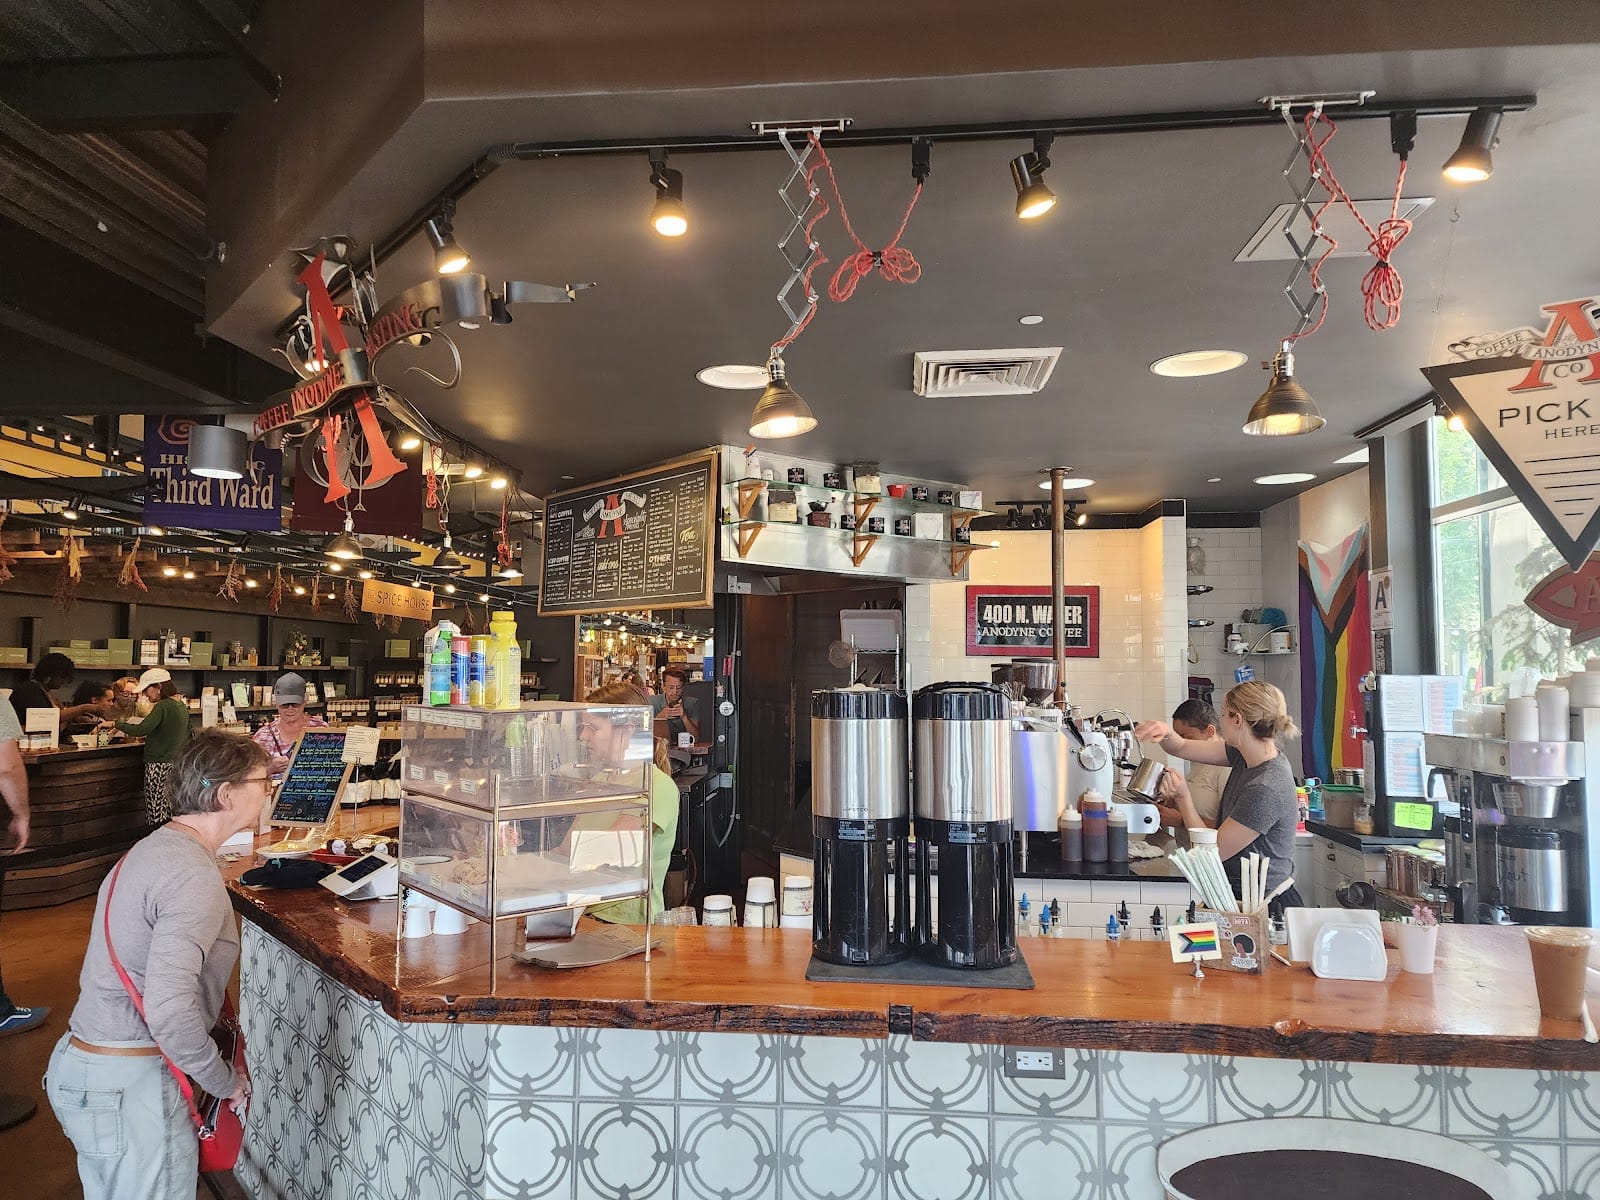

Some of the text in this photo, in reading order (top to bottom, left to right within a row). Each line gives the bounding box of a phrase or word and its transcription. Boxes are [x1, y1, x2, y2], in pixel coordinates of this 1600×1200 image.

[1475, 332, 1600, 358] COFFEE ANODYN
[1553, 362, 1584, 378] CO
[1499, 398, 1592, 428] PICK
[1545, 424, 1600, 440] HERE
[150, 466, 275, 510] Third Ward
[649, 553, 672, 563] OTHER
[377, 590, 401, 607] SPICE
[404, 595, 430, 611] HOUSE
[1375, 581, 1387, 610] A
[983, 604, 1082, 624] 400 N. WAER
[982, 626, 1035, 637] ANODYNE
